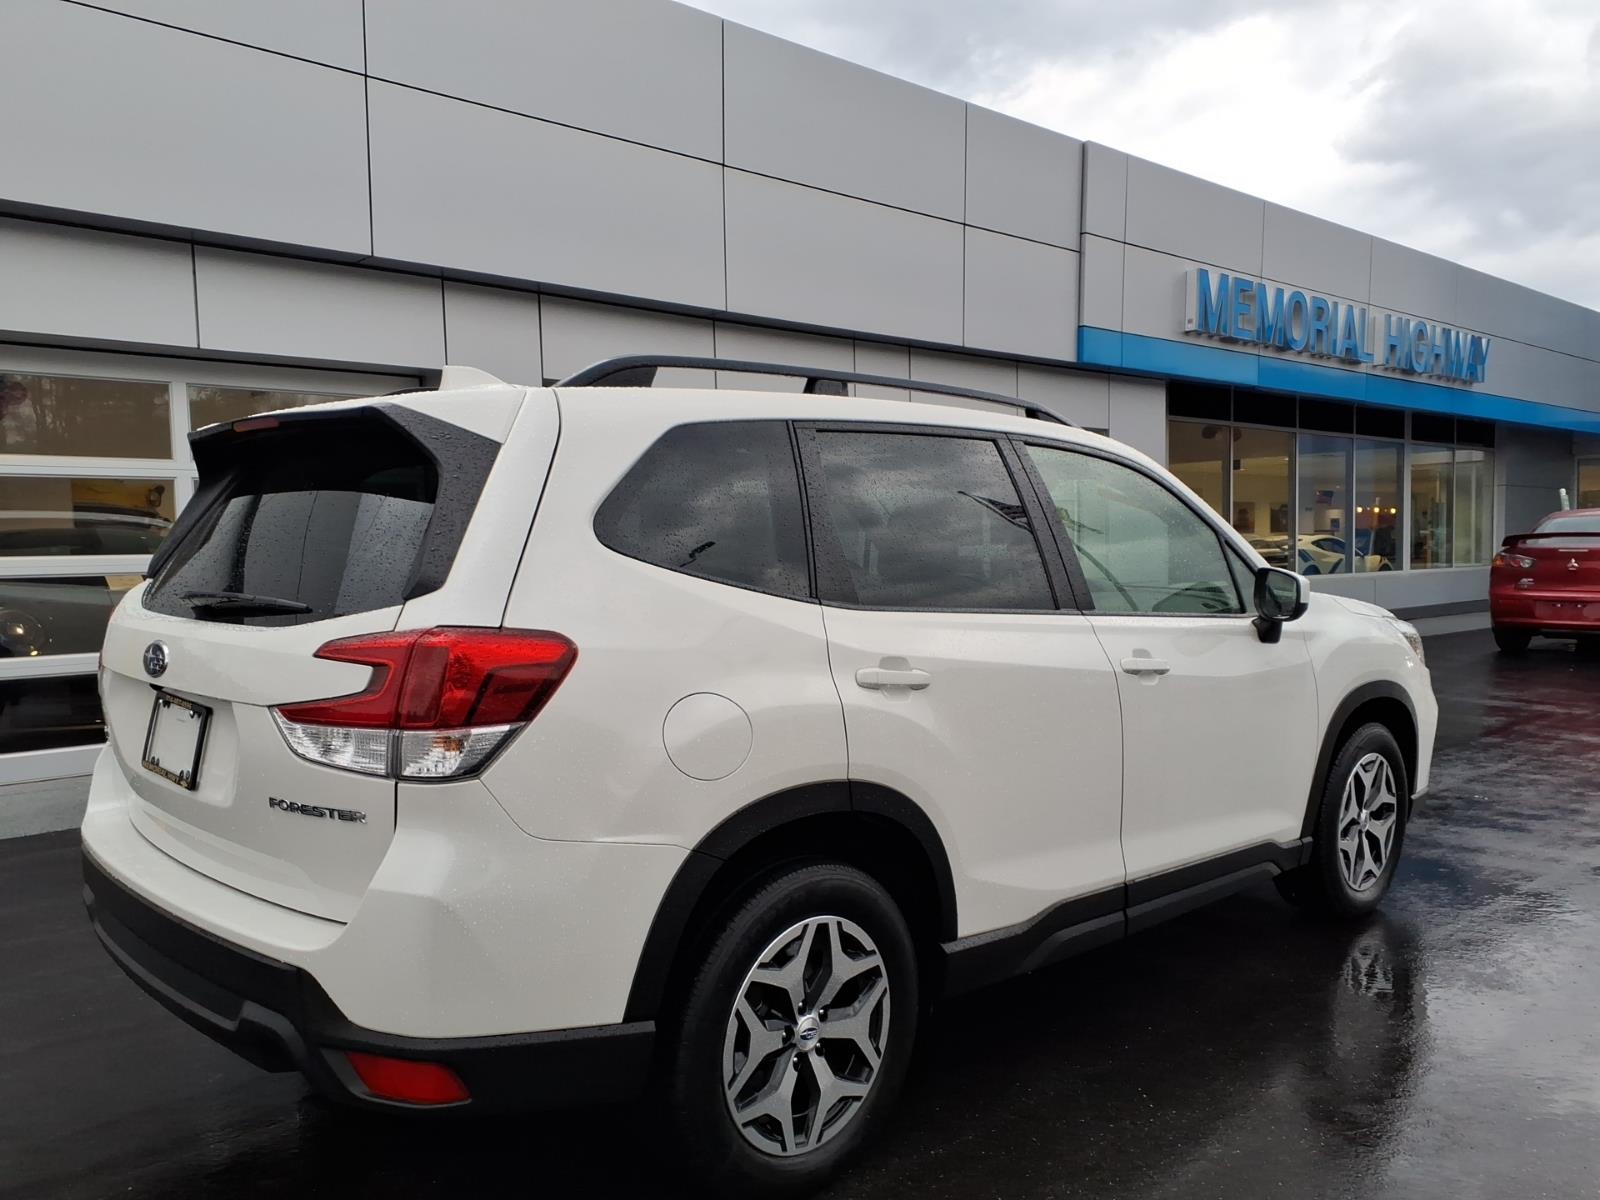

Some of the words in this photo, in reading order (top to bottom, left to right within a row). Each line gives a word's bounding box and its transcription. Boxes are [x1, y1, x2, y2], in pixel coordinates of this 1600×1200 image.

[1193, 267, 1374, 363] MEMORIAL
[1383, 312, 1491, 383] HIGHWAY
[268, 796, 367, 824] FORESTER
